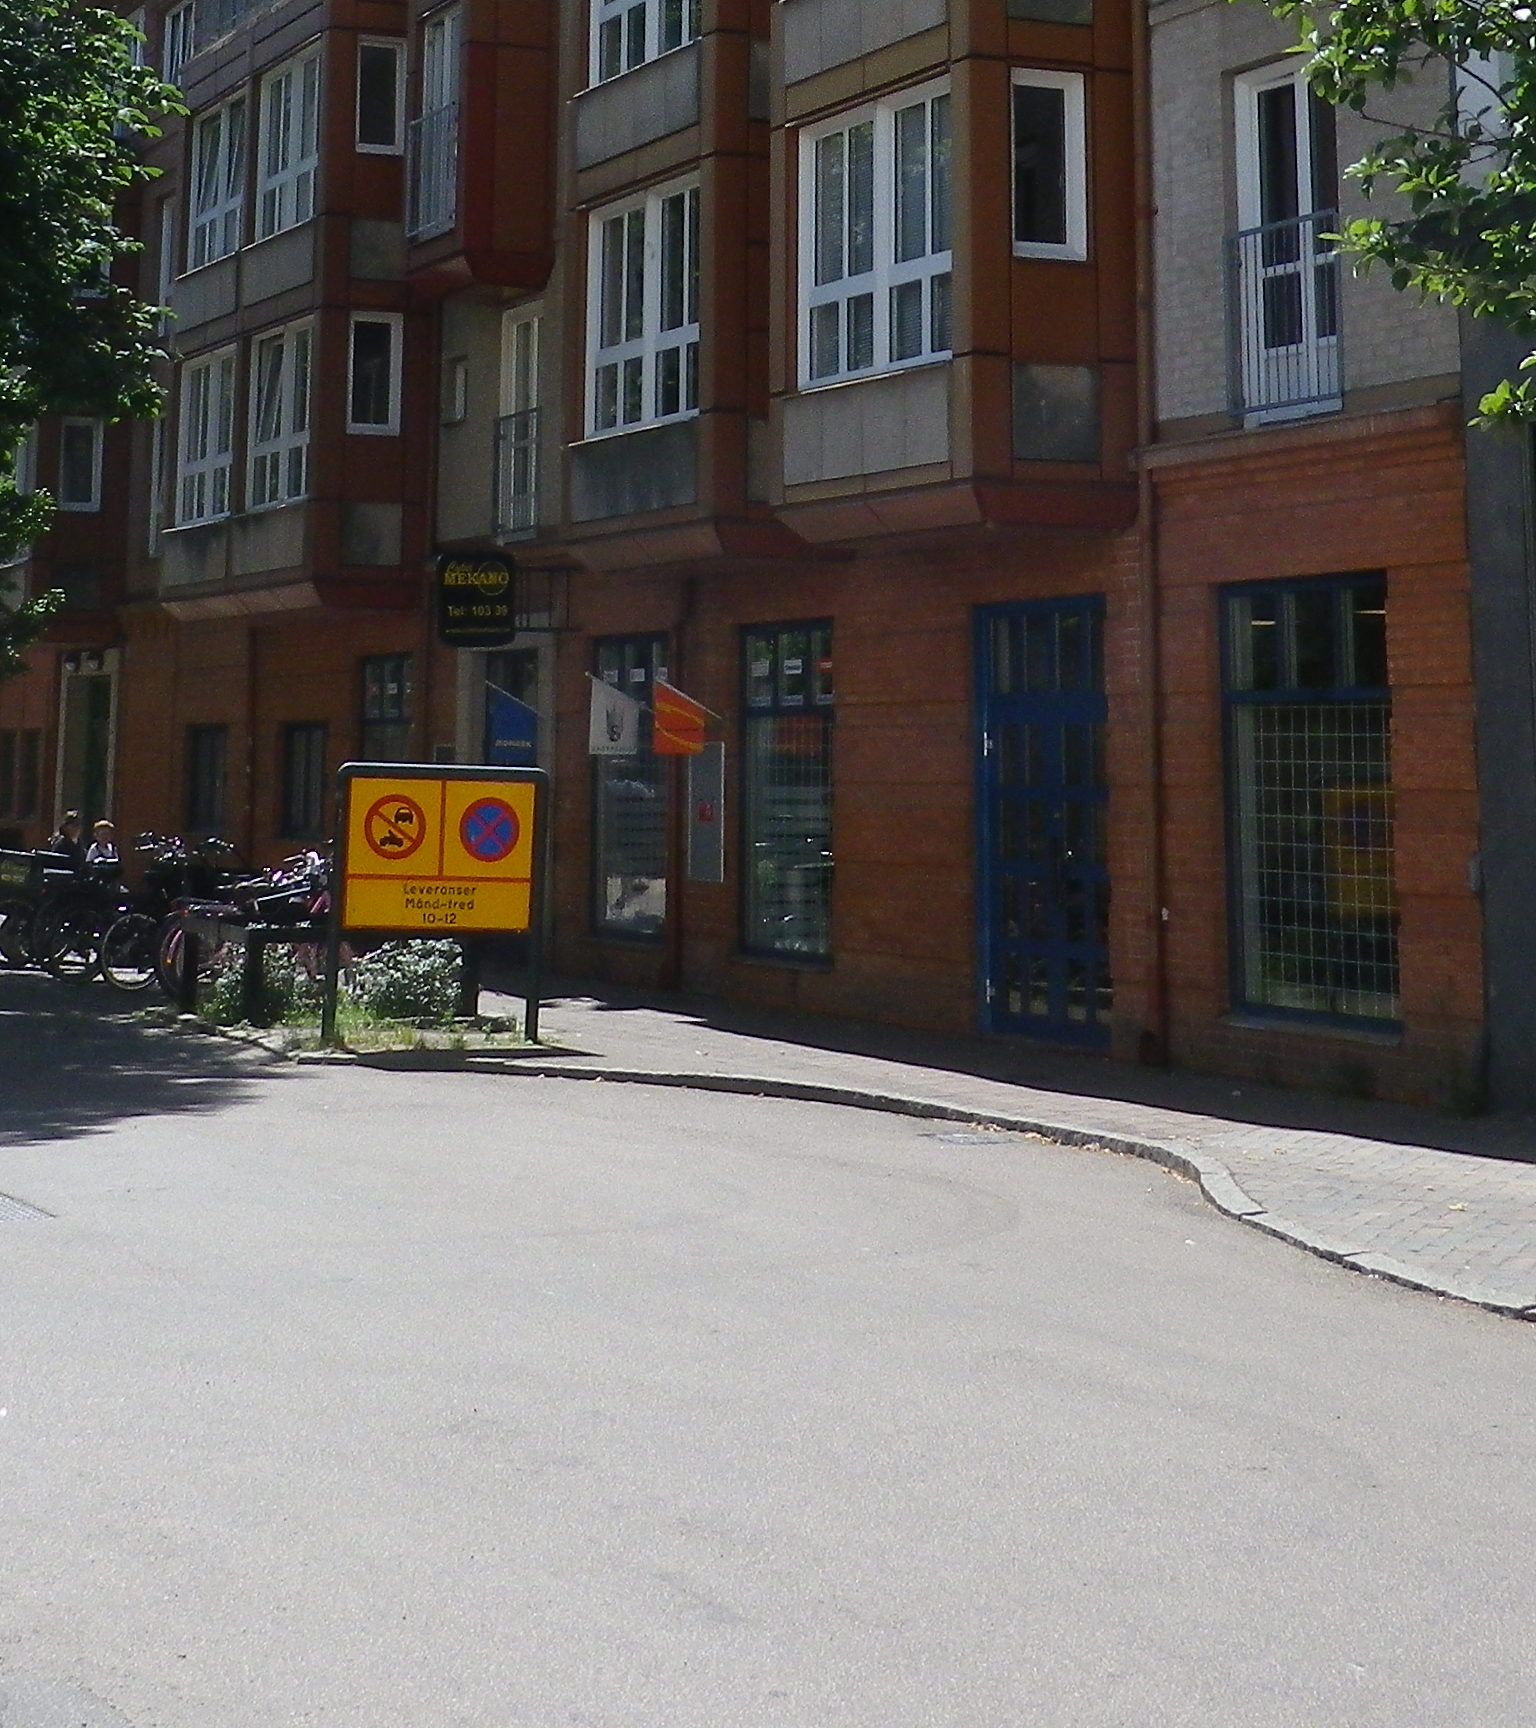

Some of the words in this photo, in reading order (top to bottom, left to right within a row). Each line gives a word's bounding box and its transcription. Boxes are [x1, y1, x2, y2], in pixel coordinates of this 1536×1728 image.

[444, 571, 510, 585] MEKANO
[404, 882, 478, 896] Leveranser
[422, 913, 457, 924] 10-12
